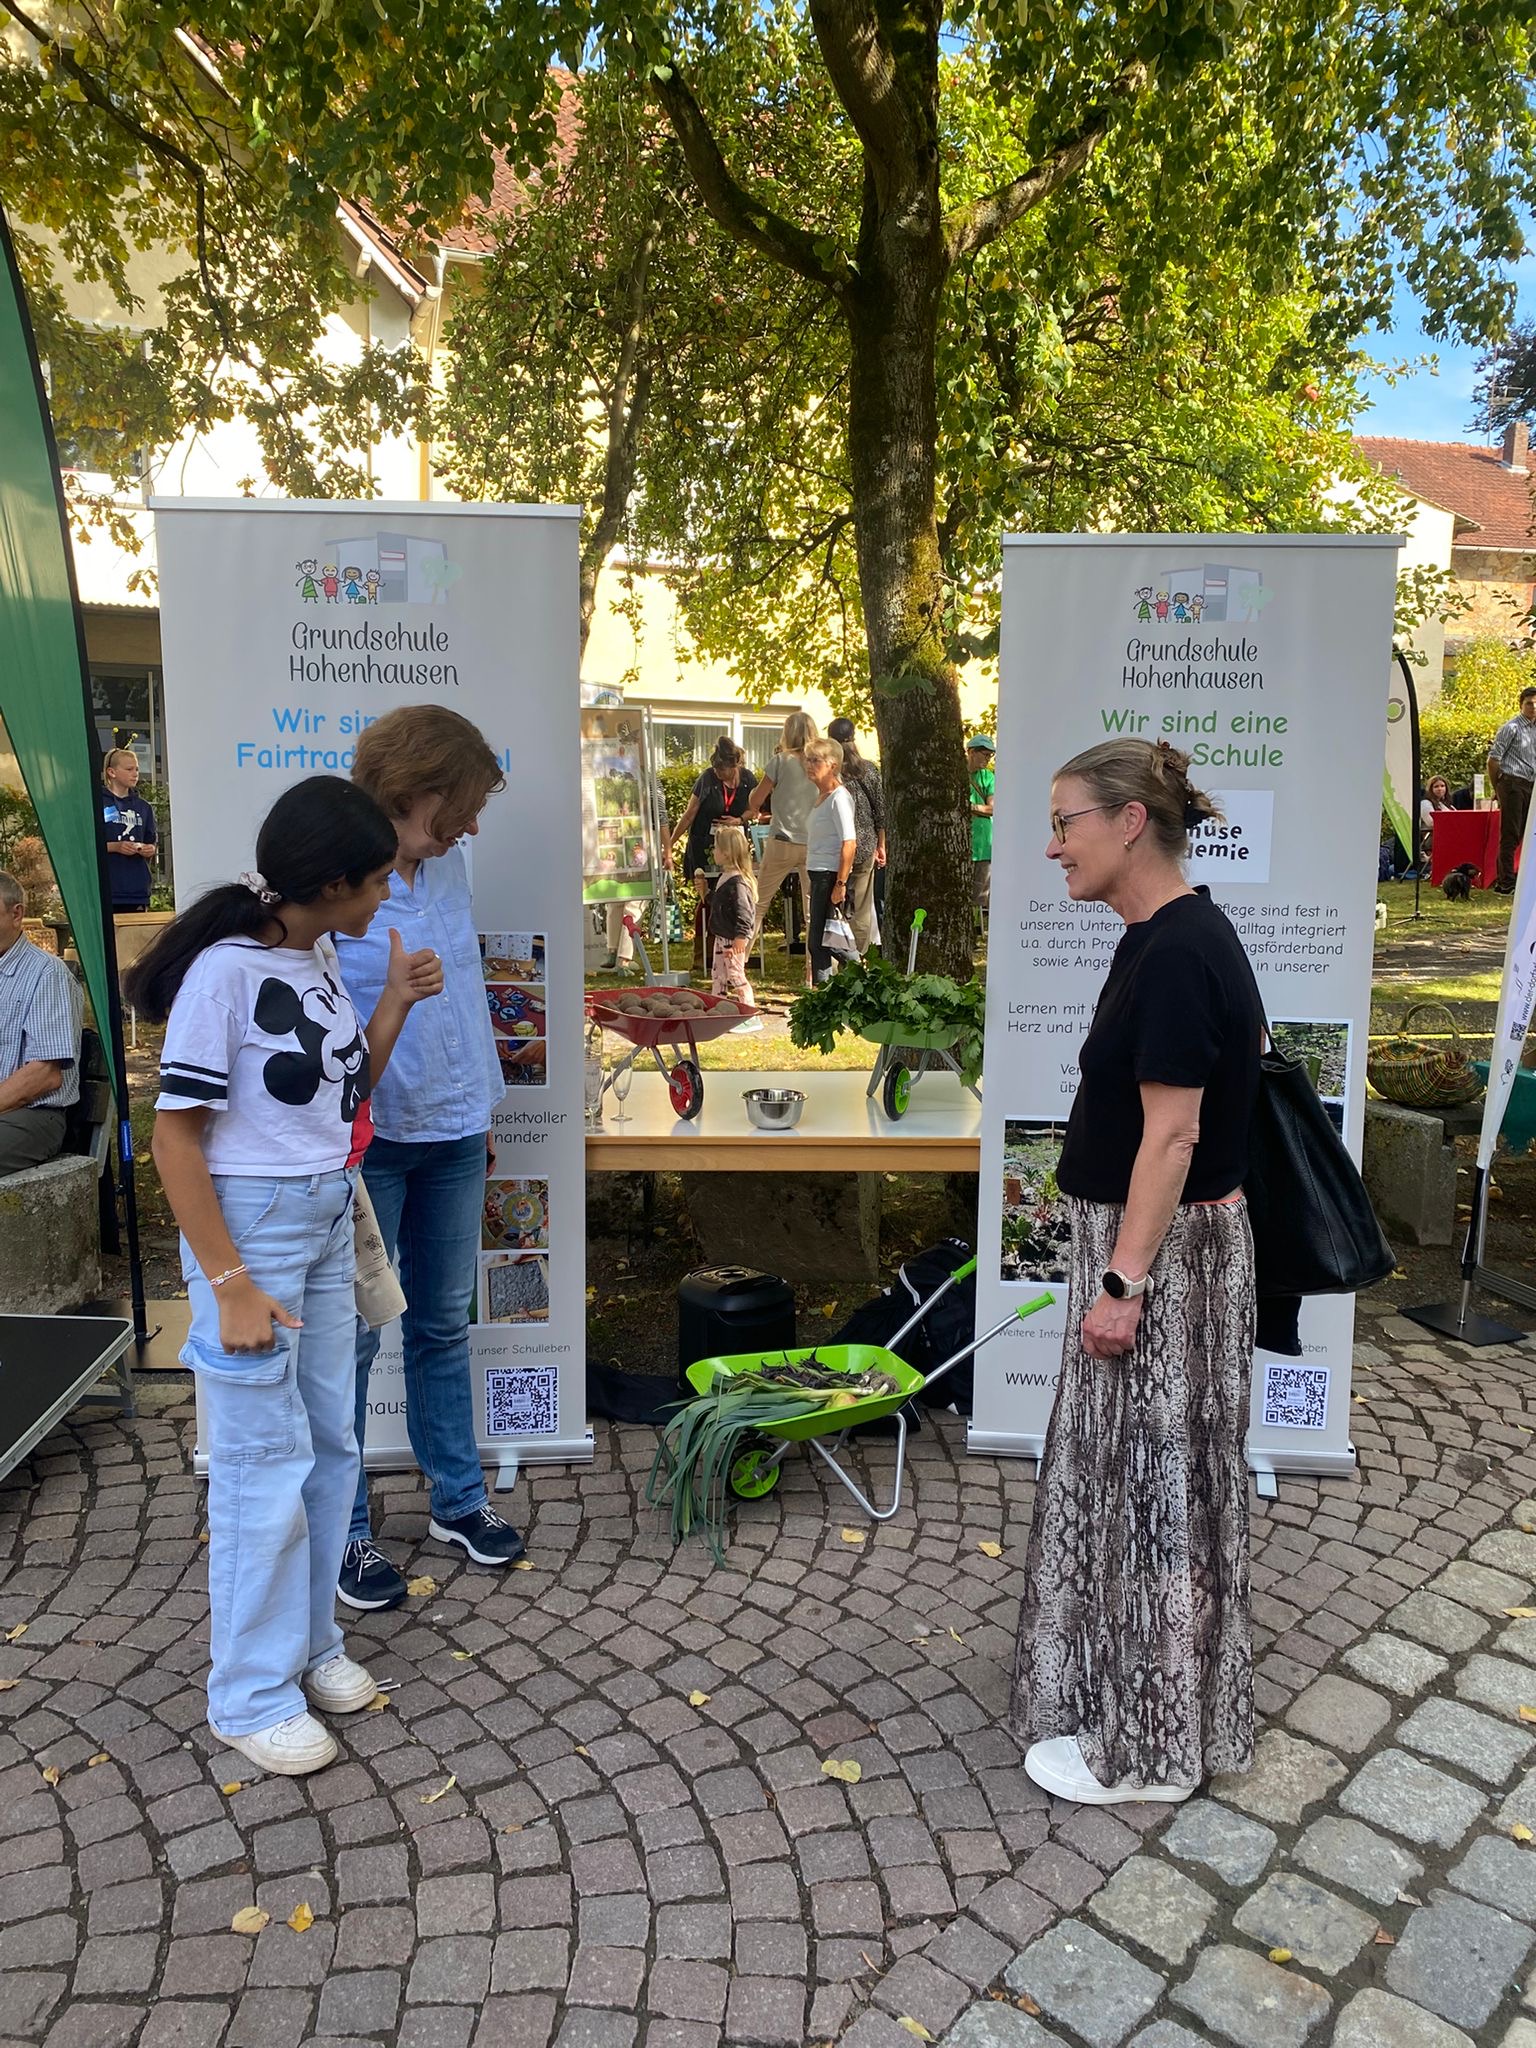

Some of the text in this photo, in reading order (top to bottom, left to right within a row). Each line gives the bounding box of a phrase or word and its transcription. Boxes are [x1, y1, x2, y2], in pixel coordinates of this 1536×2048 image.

[291, 620, 449, 651] Grundschule
[1126, 636, 1258, 662] Grundschule
[289, 653, 459, 686] Hohenhausen
[1122, 664, 1264, 690] Hohenhausen
[272, 707, 326, 734] Wir
[1101, 709, 1288, 734] Wir sind eine
[1192, 743, 1284, 767] Schule
[1029, 900, 1054, 913] Der
[1058, 900, 1115, 914] Schulac
[1260, 904, 1289, 917] sind
[1295, 904, 1321, 918] fest
[1326, 905, 1338, 918] in
[1020, 918, 1074, 931] unseren
[1080, 919, 1126, 932] Unterr
[1281, 923, 1347, 939] integriert
[1021, 938, 1042, 949] u.a.
[1047, 937, 1086, 950] durch
[1032, 955, 1069, 967] sowie
[1256, 959, 1269, 972] in
[1274, 960, 1330, 973] unserer
[1008, 1001, 1057, 1015] Lernen
[1063, 1003, 1085, 1015] mit
[1007, 1020, 1041, 1033] Herz
[1047, 1021, 1073, 1034] und
[491, 1130, 548, 1144] nander
[477, 1347, 508, 1356] unser
[512, 1343, 571, 1355] Schulleben
